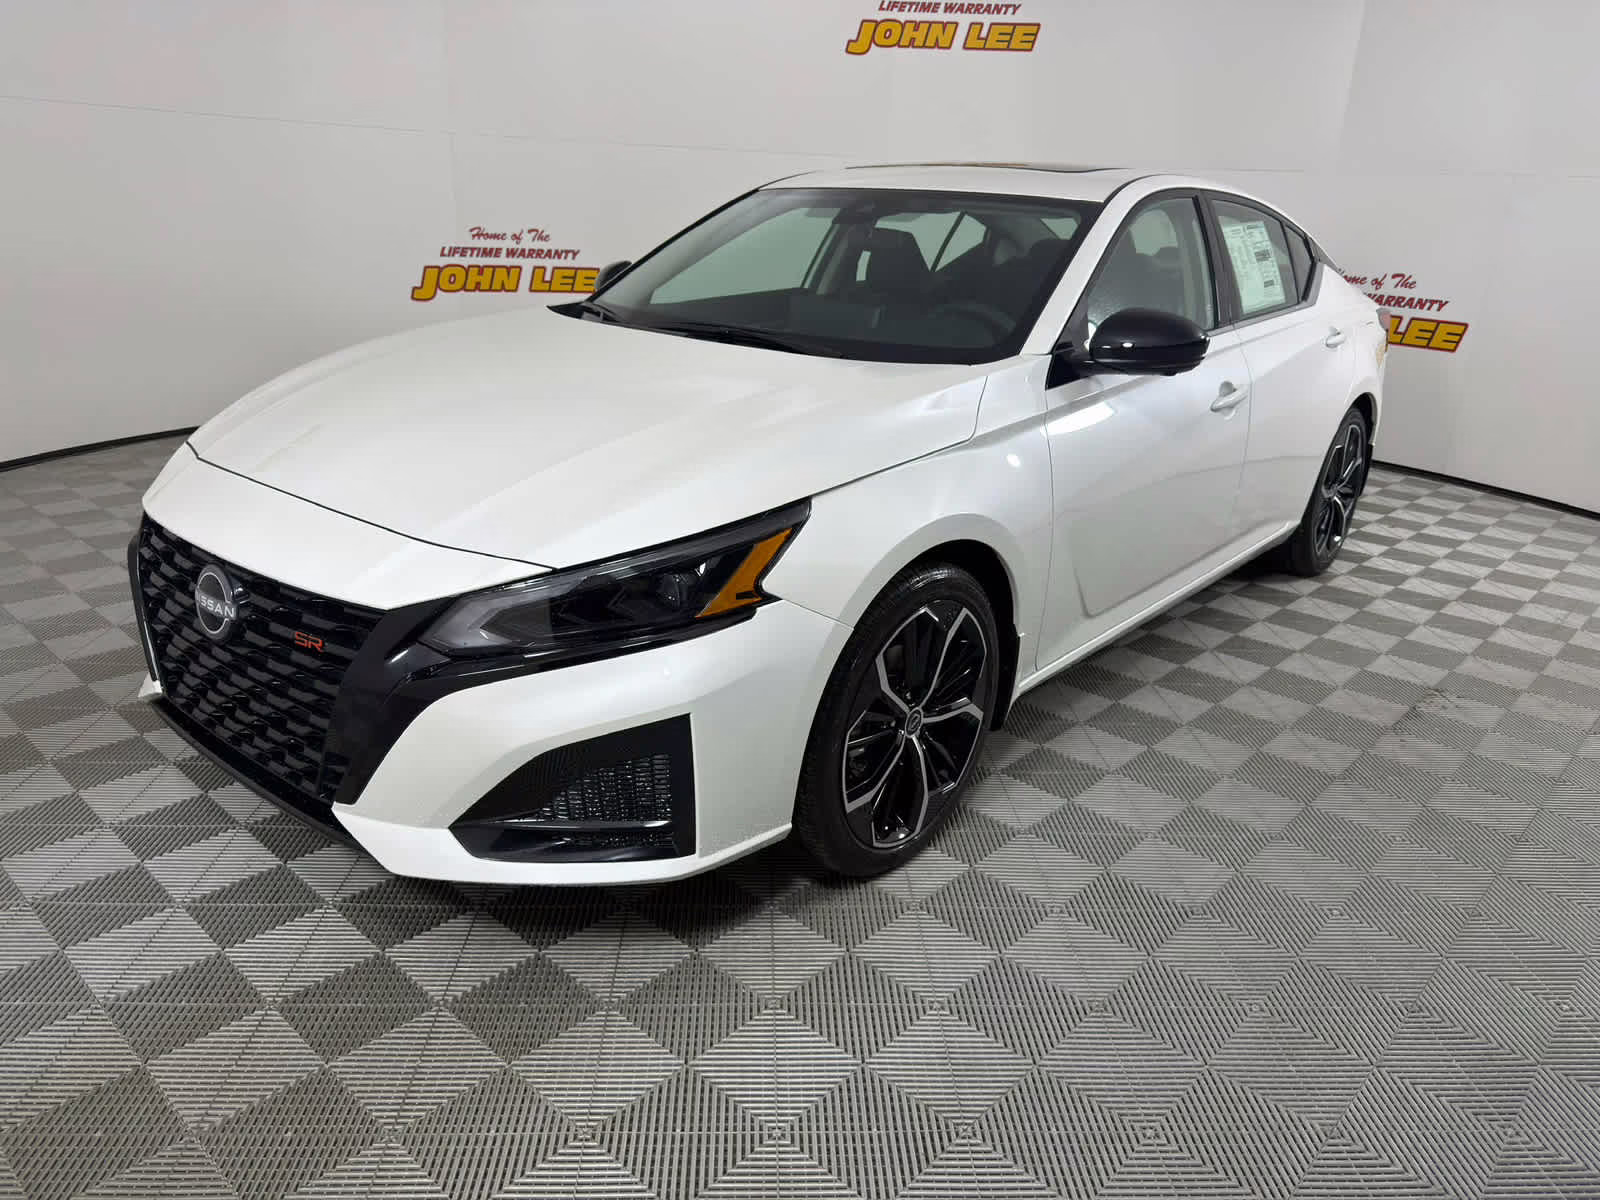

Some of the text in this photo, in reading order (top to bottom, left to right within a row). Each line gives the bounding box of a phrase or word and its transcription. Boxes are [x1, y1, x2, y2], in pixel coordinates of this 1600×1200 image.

[878, 0, 1021, 15] LIFETIME WARRANTY
[845, 19, 1041, 55] JOHN LEE
[469, 226, 551, 245] Home of The
[440, 246, 581, 261] LIFETIME WARRANTY
[411, 264, 601, 302] JOHN LEE
[1339, 268, 1417, 291] ome of The
[1387, 313, 1470, 353] LEE
[200, 594, 236, 619] SSAN
[295, 631, 324, 653] SR
